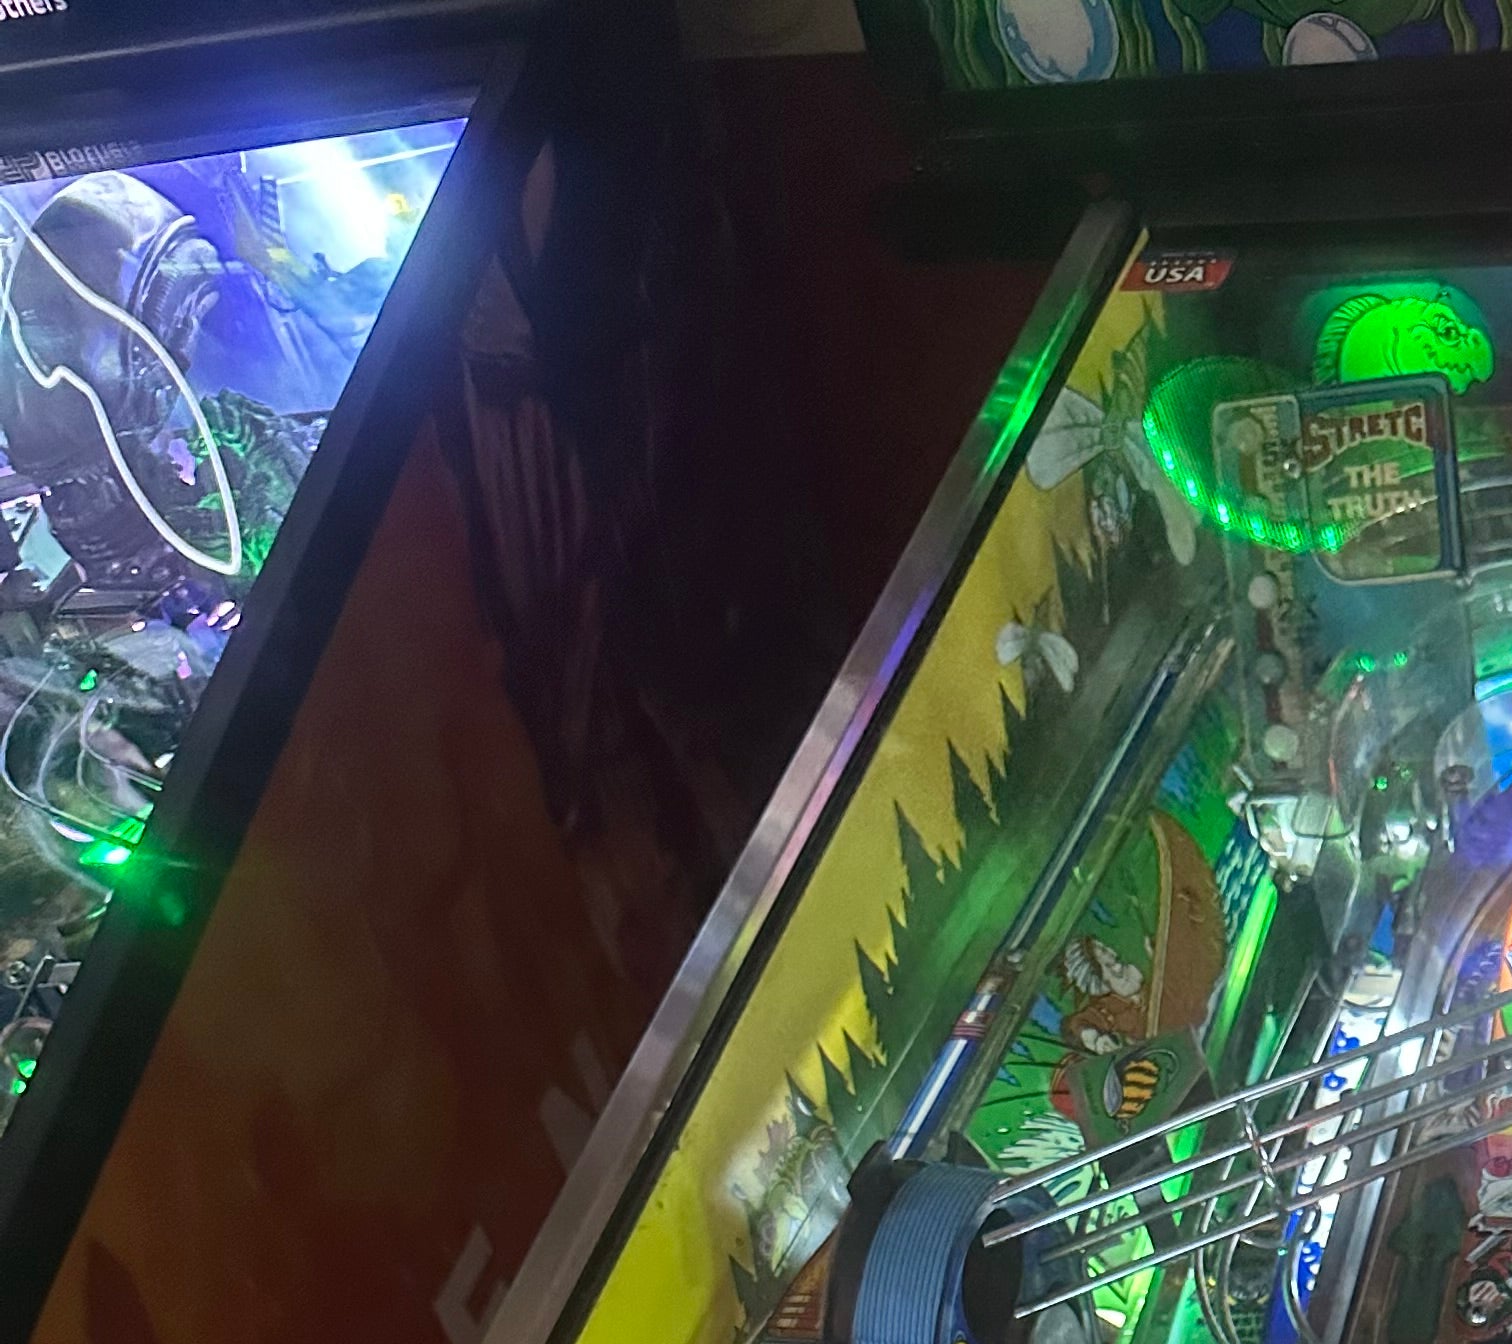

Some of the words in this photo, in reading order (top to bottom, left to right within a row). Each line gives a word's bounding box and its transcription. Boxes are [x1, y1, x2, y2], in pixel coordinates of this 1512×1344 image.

[0, 0, 68, 21] thers
[1144, 265, 1205, 285] USA
[1303, 403, 1431, 473] STRETC
[1345, 462, 1399, 488] THE
